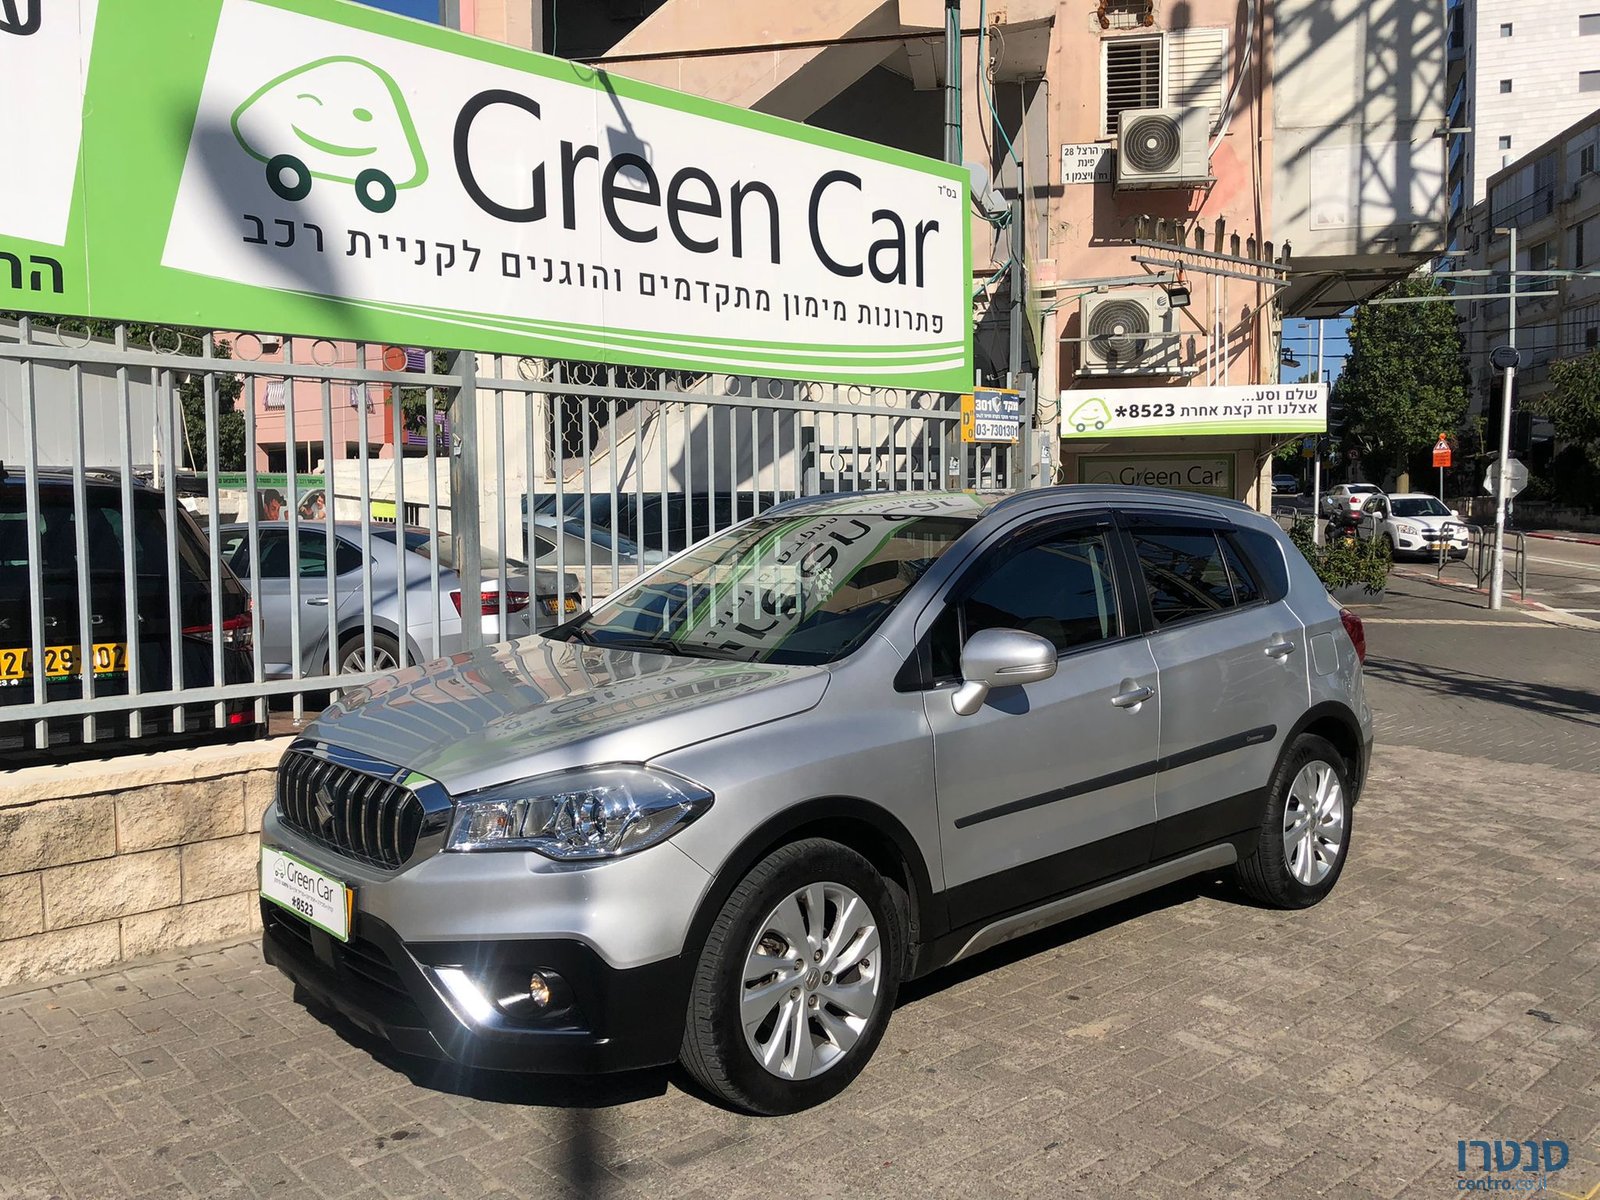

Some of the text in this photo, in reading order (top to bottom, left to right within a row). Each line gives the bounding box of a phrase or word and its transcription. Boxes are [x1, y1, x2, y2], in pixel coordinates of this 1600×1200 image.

[1065, 147, 1075, 156] 28
[1077, 145, 1099, 155] הרצל
[1078, 159, 1095, 167] פינת
[453, 88, 940, 289] Green Car
[938, 185, 957, 199] בס"ד
[243, 214, 944, 335] פתרונות מימון מתקדמים והוגנים לקניית רכב
[1241, 388, 1318, 402] שלם וסע...
[975, 399, 992, 411] 301
[1180, 405, 1219, 417] אחרת
[1223, 403, 1252, 418] קצת
[1258, 403, 1273, 415] זה
[1278, 402, 1318, 414] אצלנו
[976, 424, 1018, 438] 03-7301301
[1119, 466, 1224, 486] Green Car
[286, 861, 315, 895] Green
[317, 877, 334, 903] Car
